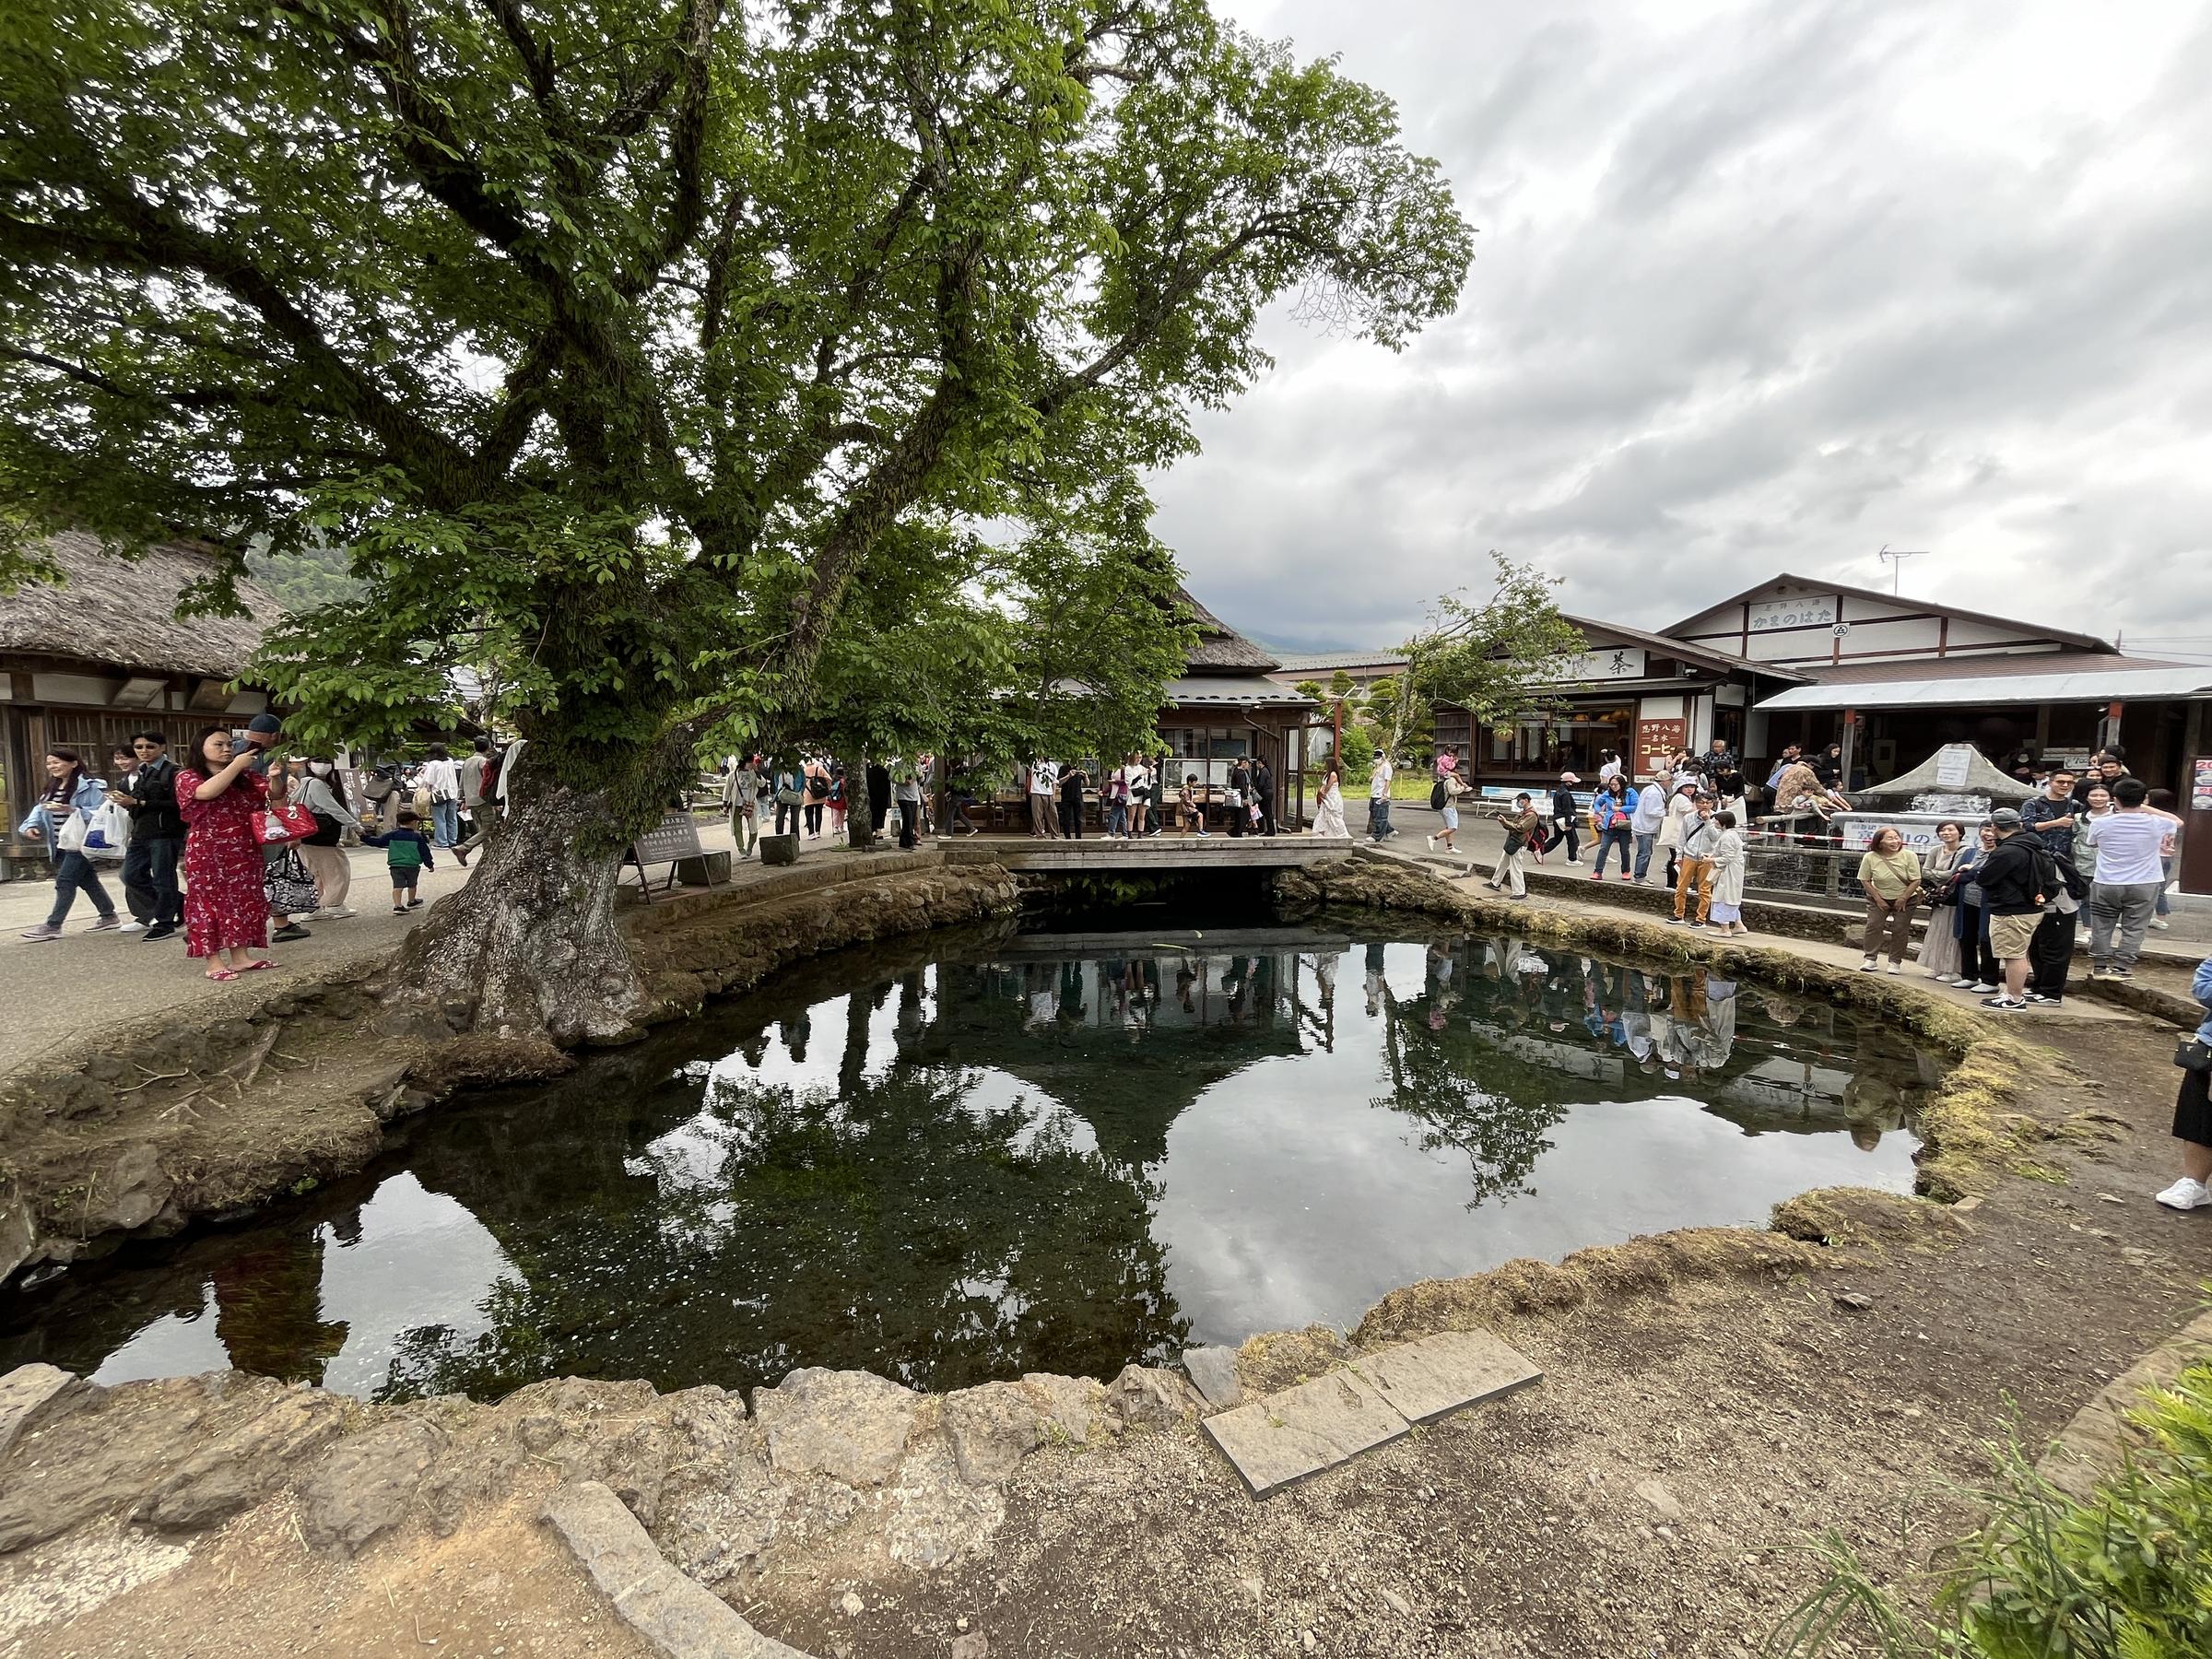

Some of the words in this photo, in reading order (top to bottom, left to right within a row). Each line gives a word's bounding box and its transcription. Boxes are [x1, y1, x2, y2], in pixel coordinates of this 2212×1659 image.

[1753, 609, 1831, 628] かまのはた
